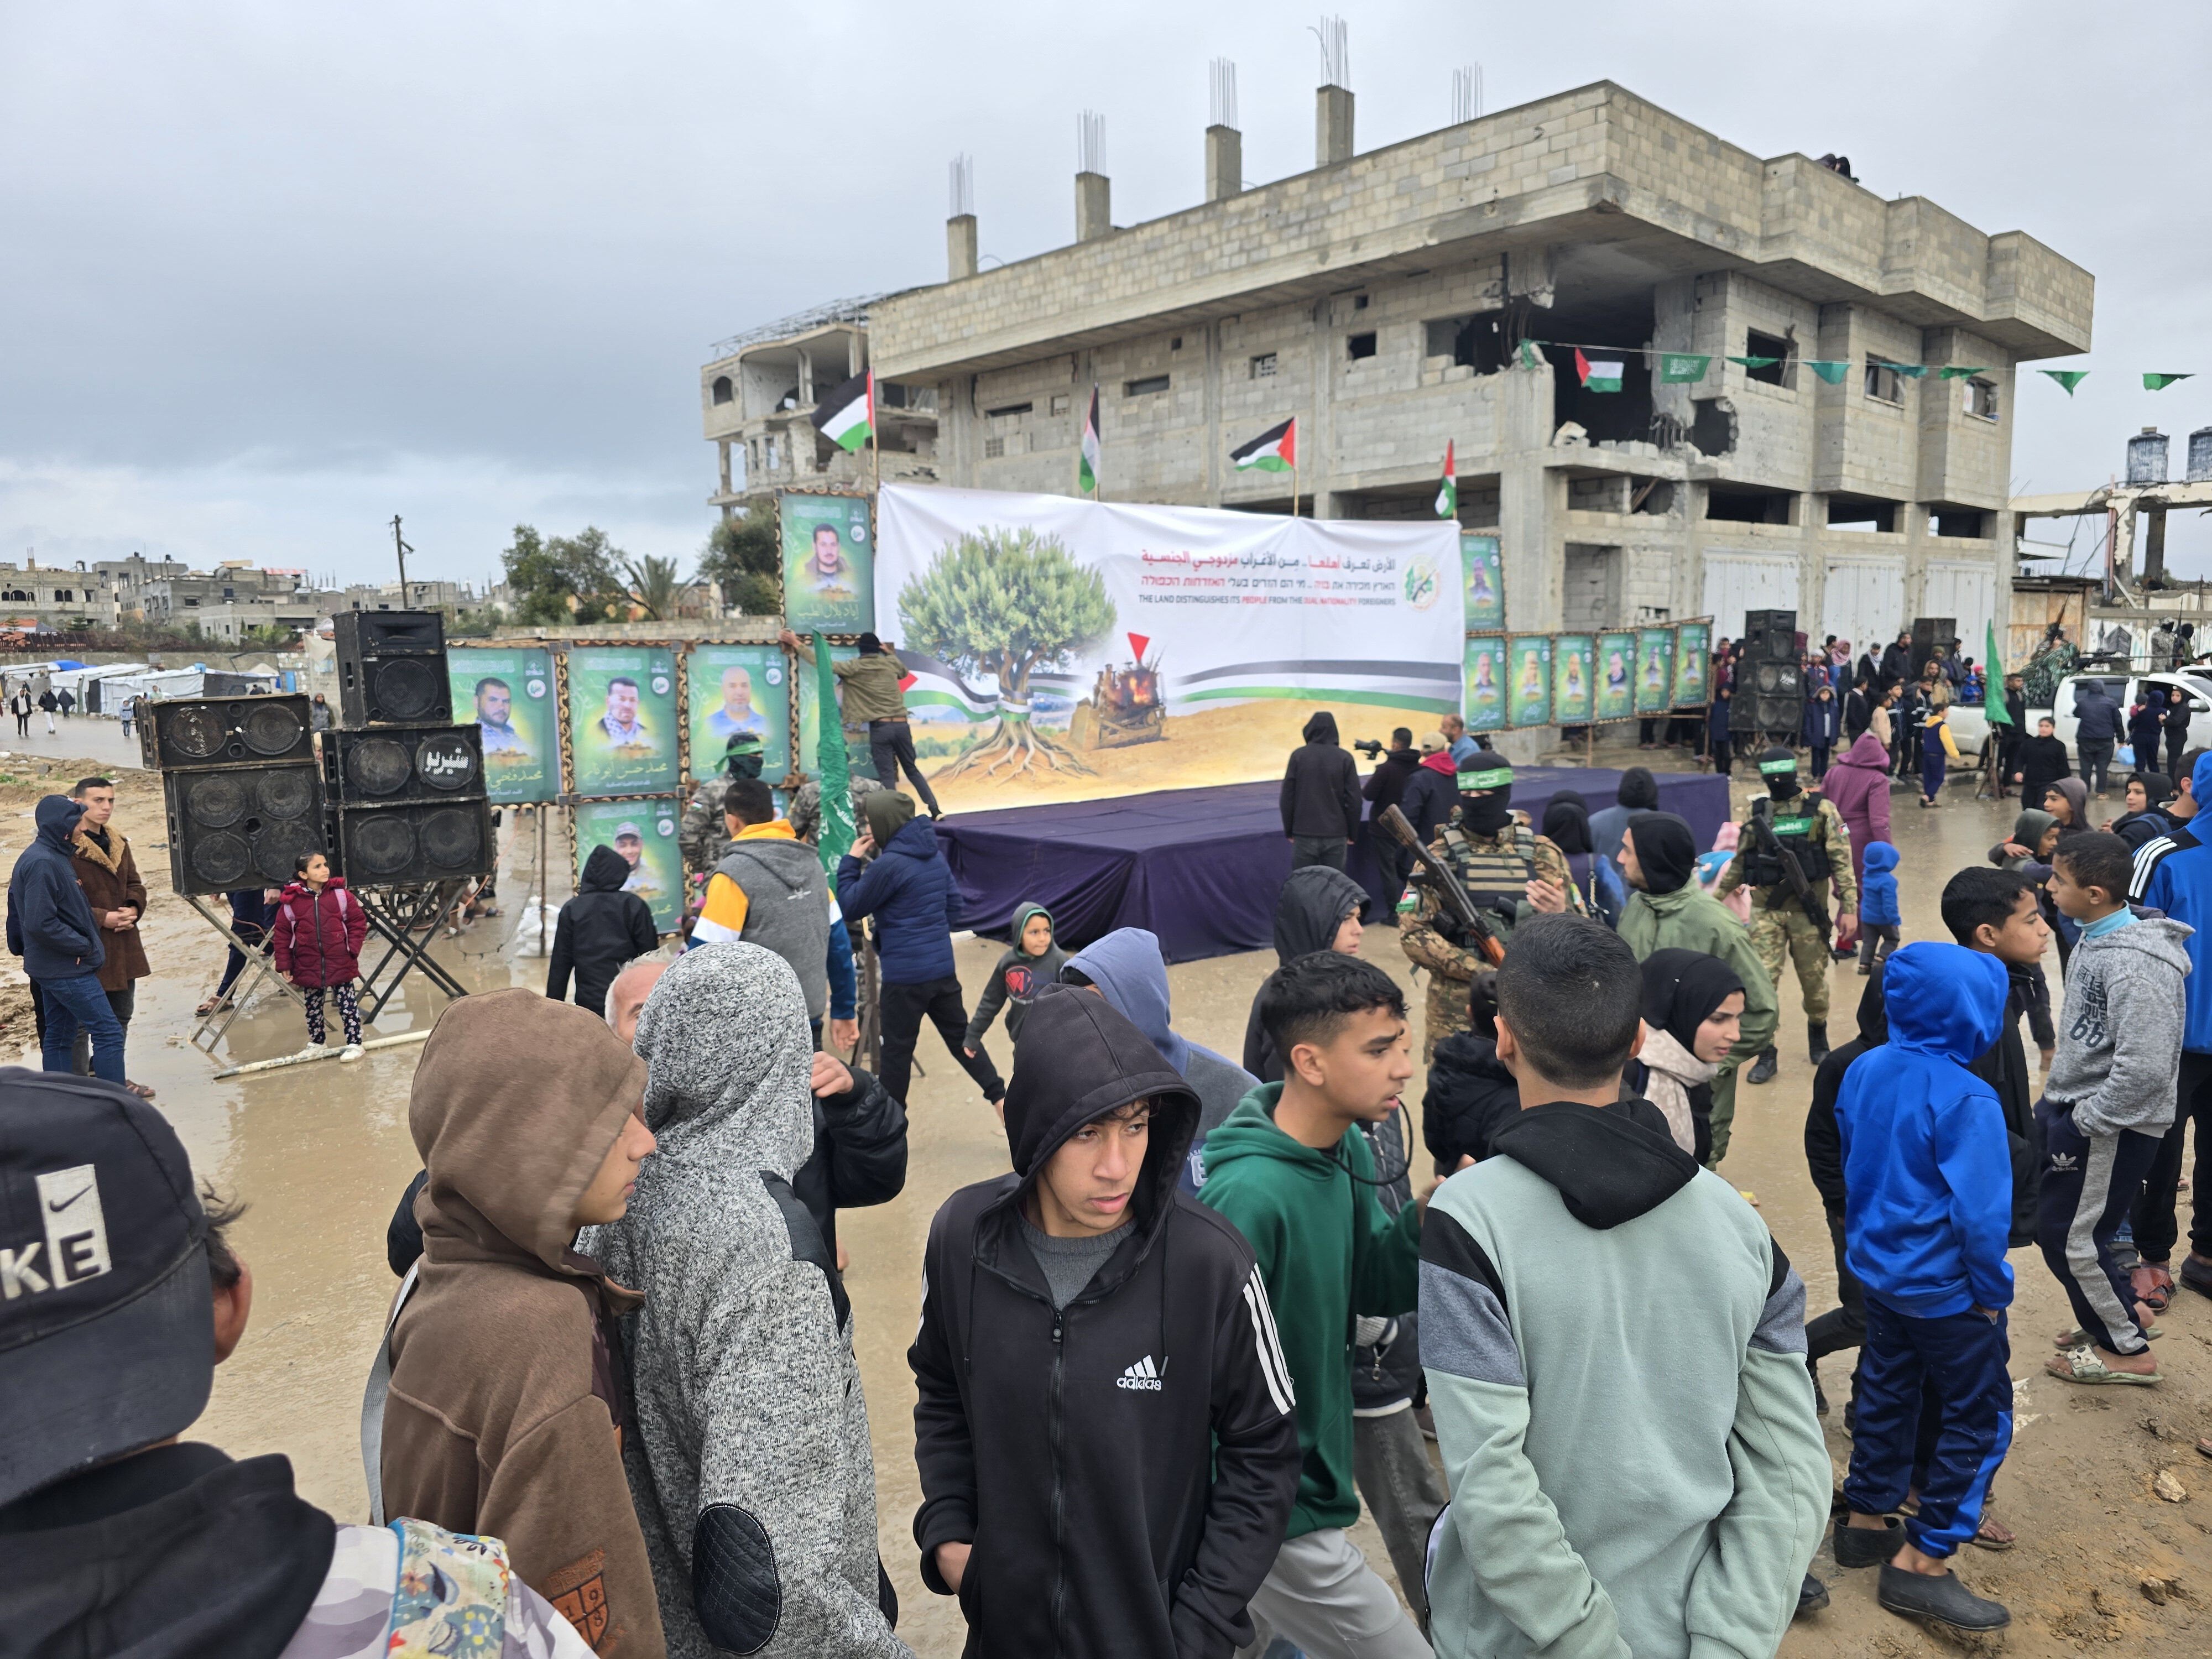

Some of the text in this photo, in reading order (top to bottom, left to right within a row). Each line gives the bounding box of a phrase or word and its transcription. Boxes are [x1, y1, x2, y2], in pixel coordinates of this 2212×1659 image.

[1139, 594, 1153, 603] THE
[1176, 595, 1228, 603] DISTINGUISHES
[1241, 596, 1267, 604] PEOPLE
[2070, 1014, 2105, 1047] 66
[0, 1229, 102, 1300] KE
[1117, 1375, 1162, 1391] adidas
